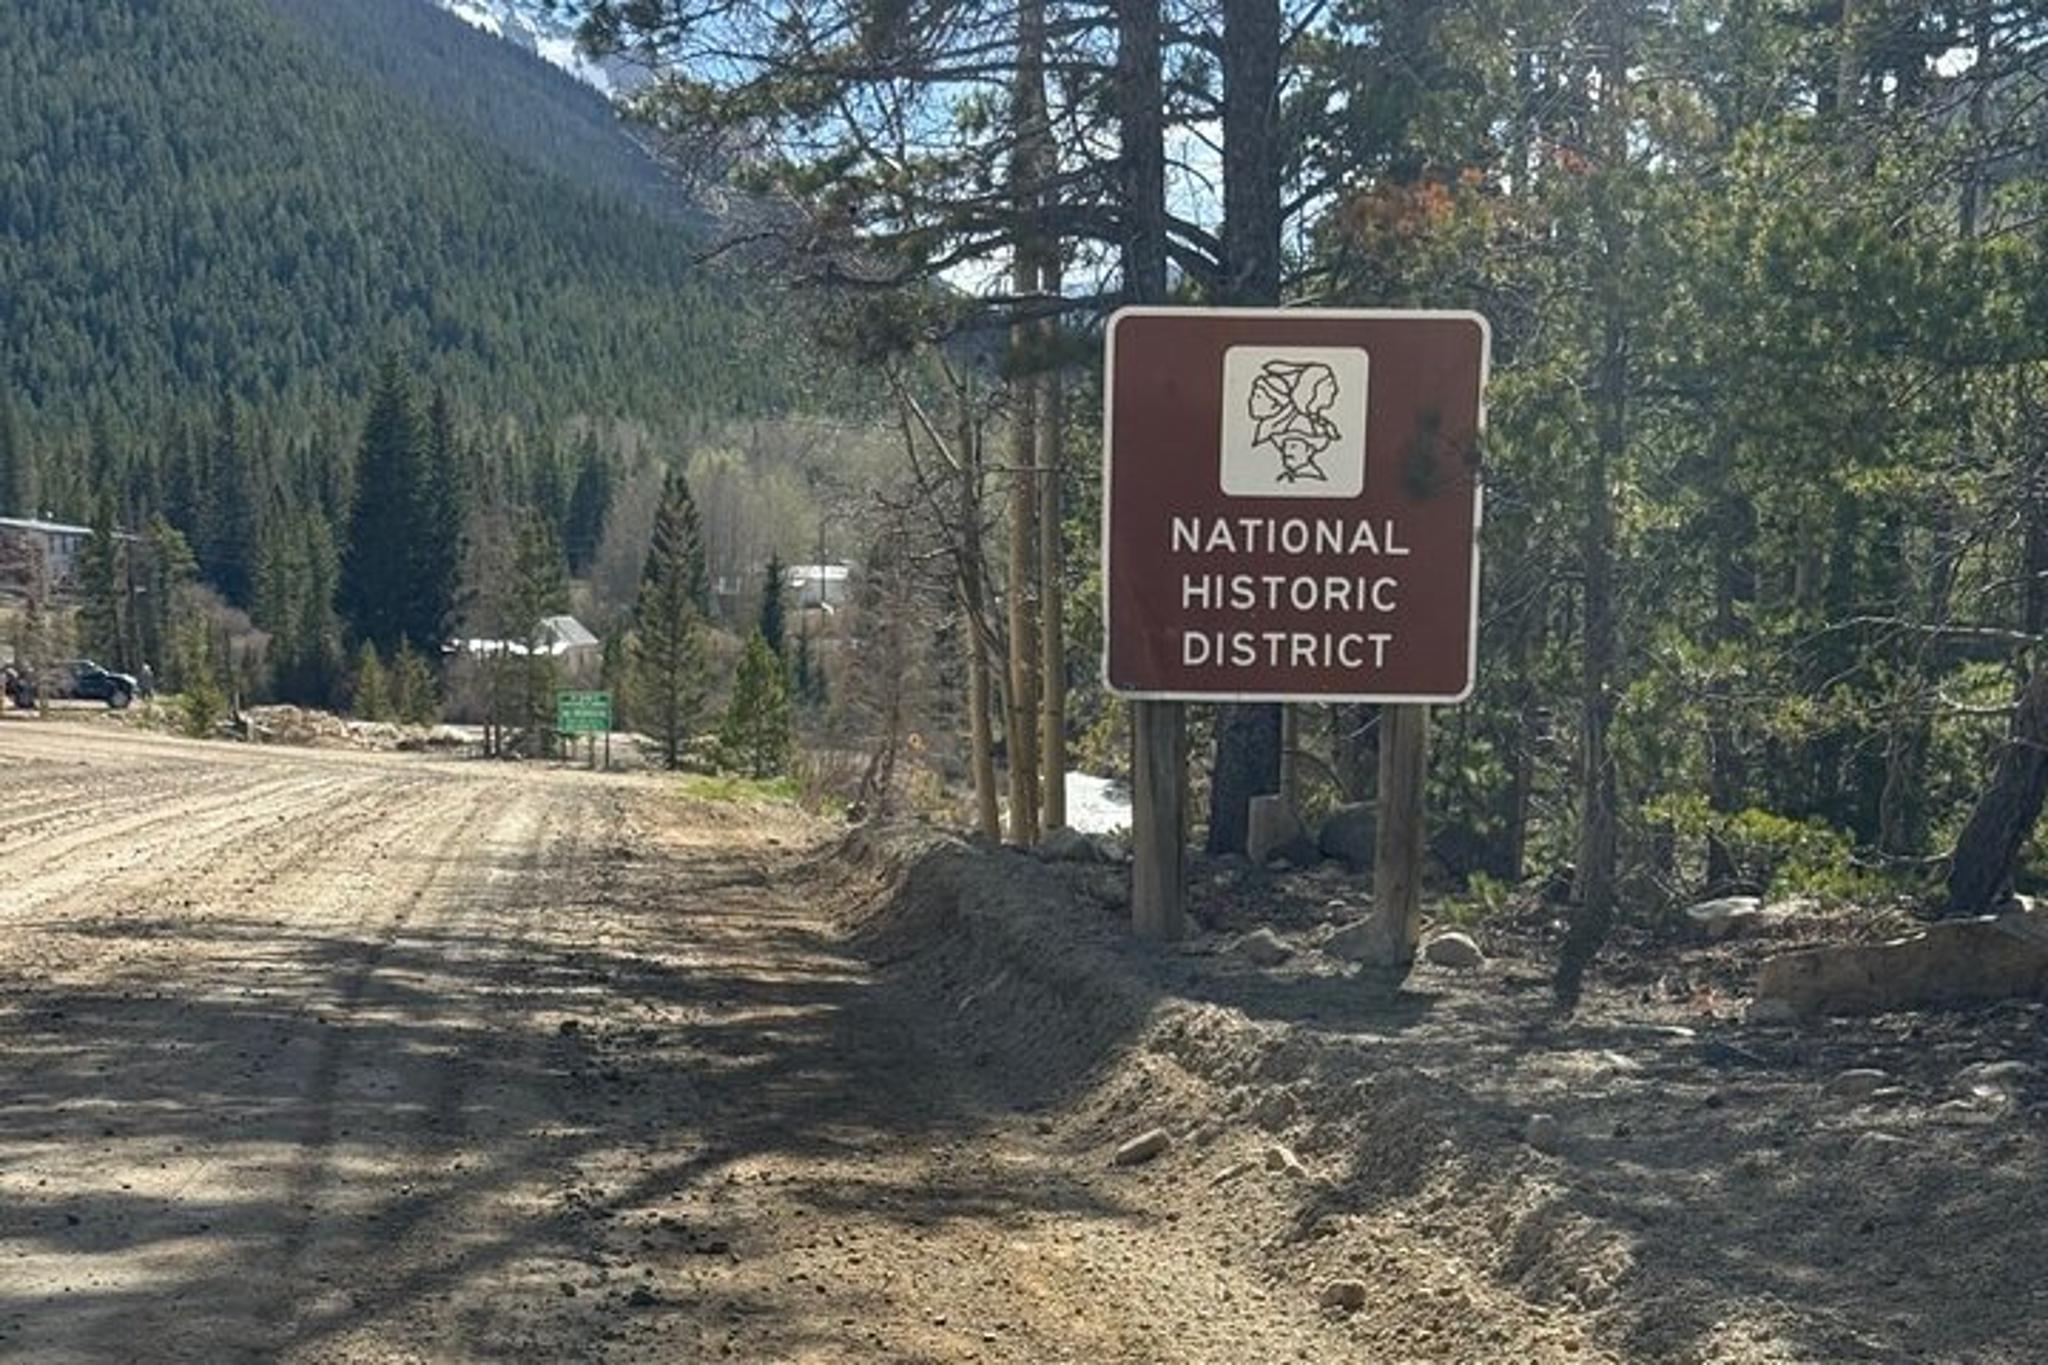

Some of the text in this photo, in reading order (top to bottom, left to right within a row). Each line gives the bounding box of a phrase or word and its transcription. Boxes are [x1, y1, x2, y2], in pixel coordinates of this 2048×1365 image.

[1172, 517, 1410, 555] NATIONAL
[1182, 575, 1398, 611] HISTORIC
[1183, 631, 1393, 667] DISTRICT
